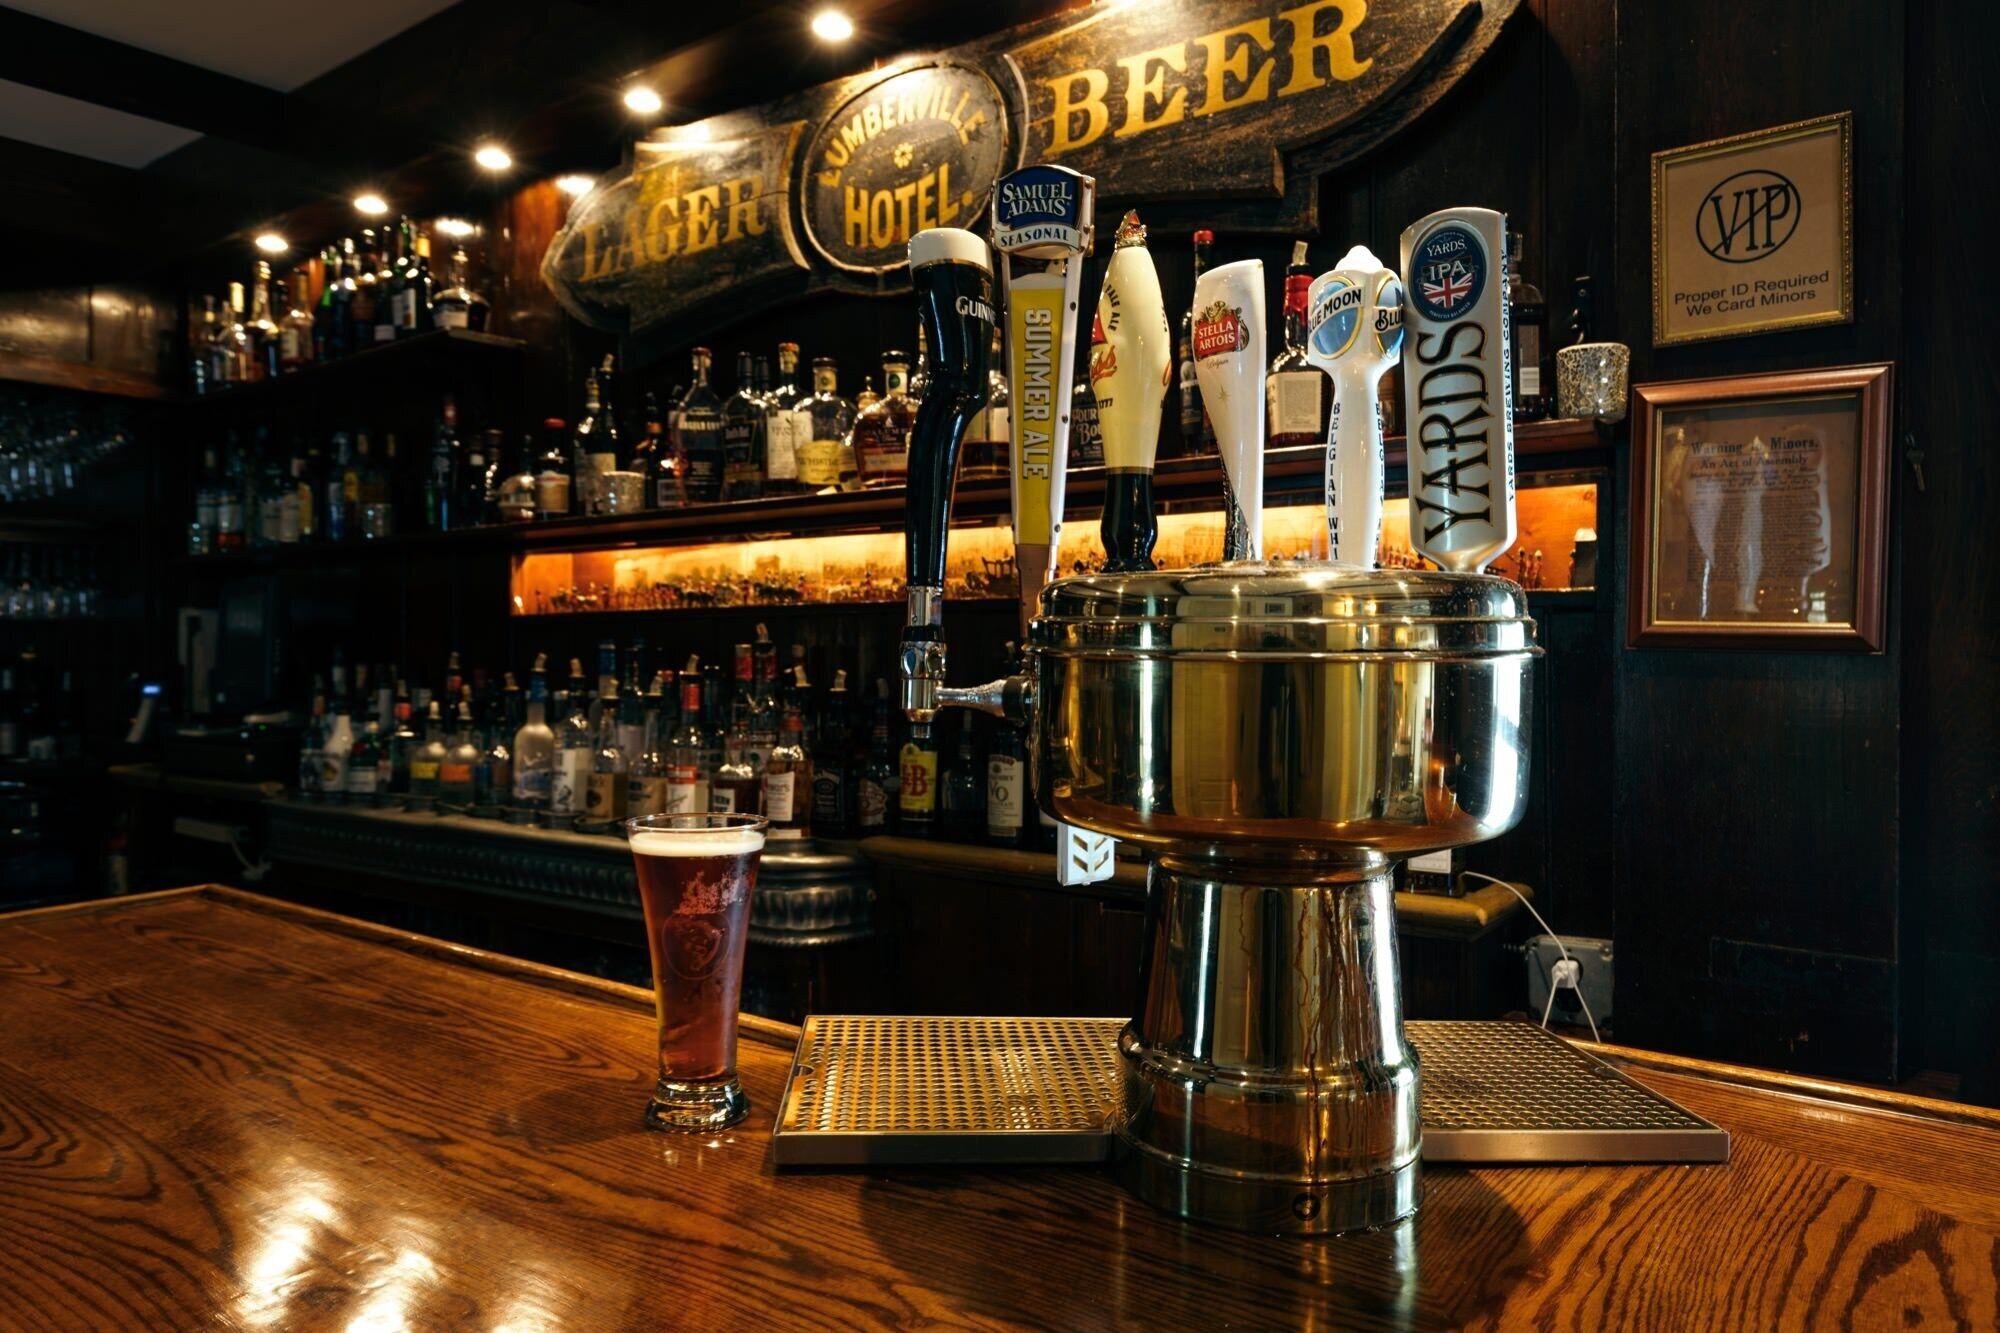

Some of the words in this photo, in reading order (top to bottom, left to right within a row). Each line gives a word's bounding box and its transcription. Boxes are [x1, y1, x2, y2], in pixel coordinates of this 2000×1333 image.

[1042, 0, 1373, 156] BEER
[1002, 181, 1073, 203] SAMUEL
[1006, 199, 1067, 220] ADAMS
[1710, 183, 1790, 255] VIP
[579, 175, 766, 283] LAGER
[1000, 227, 1069, 248] SEASONAL
[1427, 239, 1465, 257] YARDS
[1429, 260, 1467, 281] IPA
[1675, 288, 1726, 304] Proper
[1732, 283, 1749, 296] ID
[1754, 270, 1829, 293] Required
[1686, 304, 1712, 317] We
[1717, 297, 1755, 312] Card
[1761, 289, 1816, 306] Minors
[1323, 289, 1362, 319] MOON
[1108, 312, 1120, 332] ALE
[1199, 321, 1234, 339] STELLA
[1200, 332, 1235, 350] ARTOIS
[1024, 309, 1052, 421] SUMMER
[1503, 348, 1513, 433] BREWING
[1415, 321, 1494, 544] YARDS
[1022, 429, 1050, 480] ALE
[1327, 402, 1341, 507] BELGIAN
[1328, 517, 1338, 560] WHI
